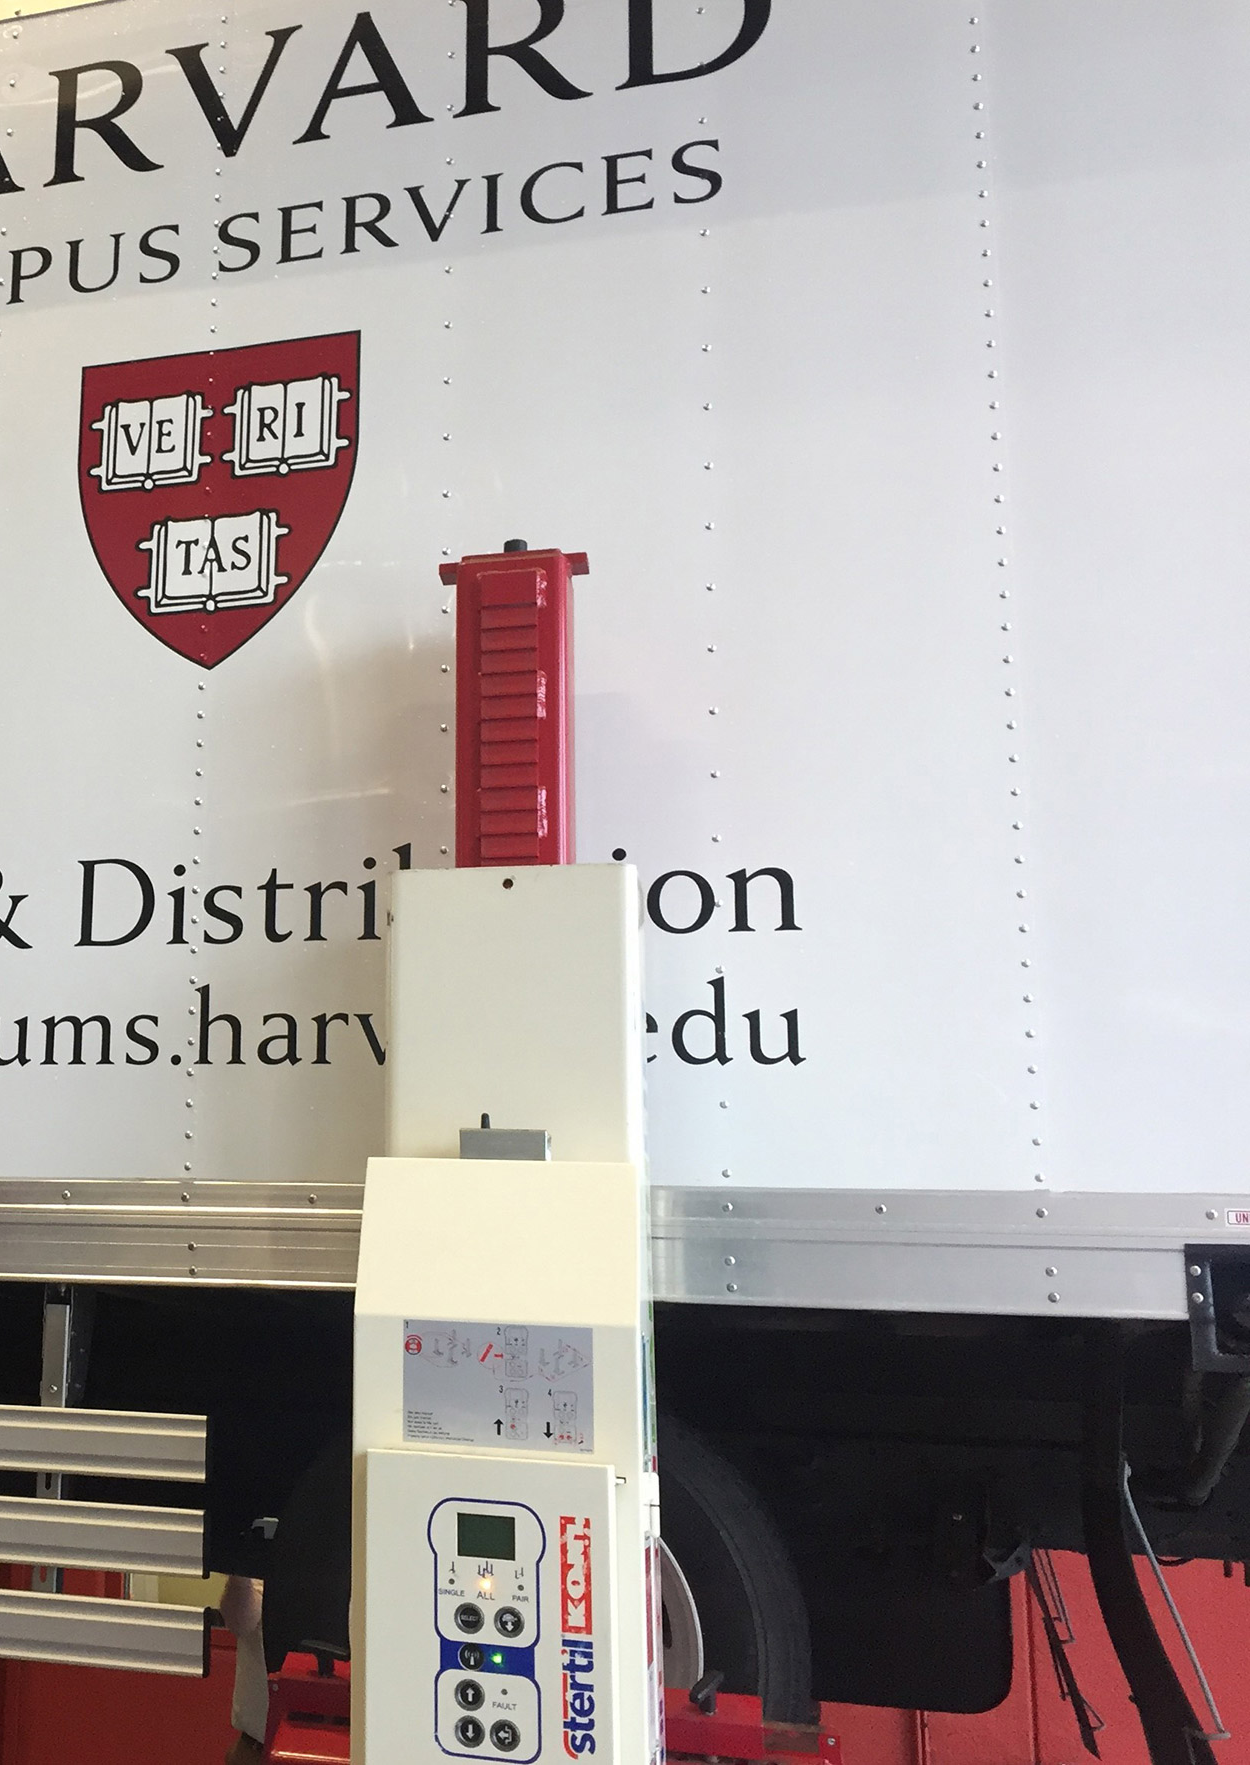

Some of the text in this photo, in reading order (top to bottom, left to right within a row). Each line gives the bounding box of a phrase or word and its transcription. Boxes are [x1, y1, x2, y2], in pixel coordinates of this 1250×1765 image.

[218, 139, 722, 274] SERVICES
[120, 402, 306, 456] VE RI
[175, 534, 252, 577] TAS
[496, 1326, 502, 1336] 2
[438, 1588, 465, 1598] SINGLE
[476, 1591, 496, 1601] ALL
[511, 1595, 530, 1603] PAIR
[561, 1638, 597, 1757] stertil
[492, 1702, 517, 1711] FAULT
